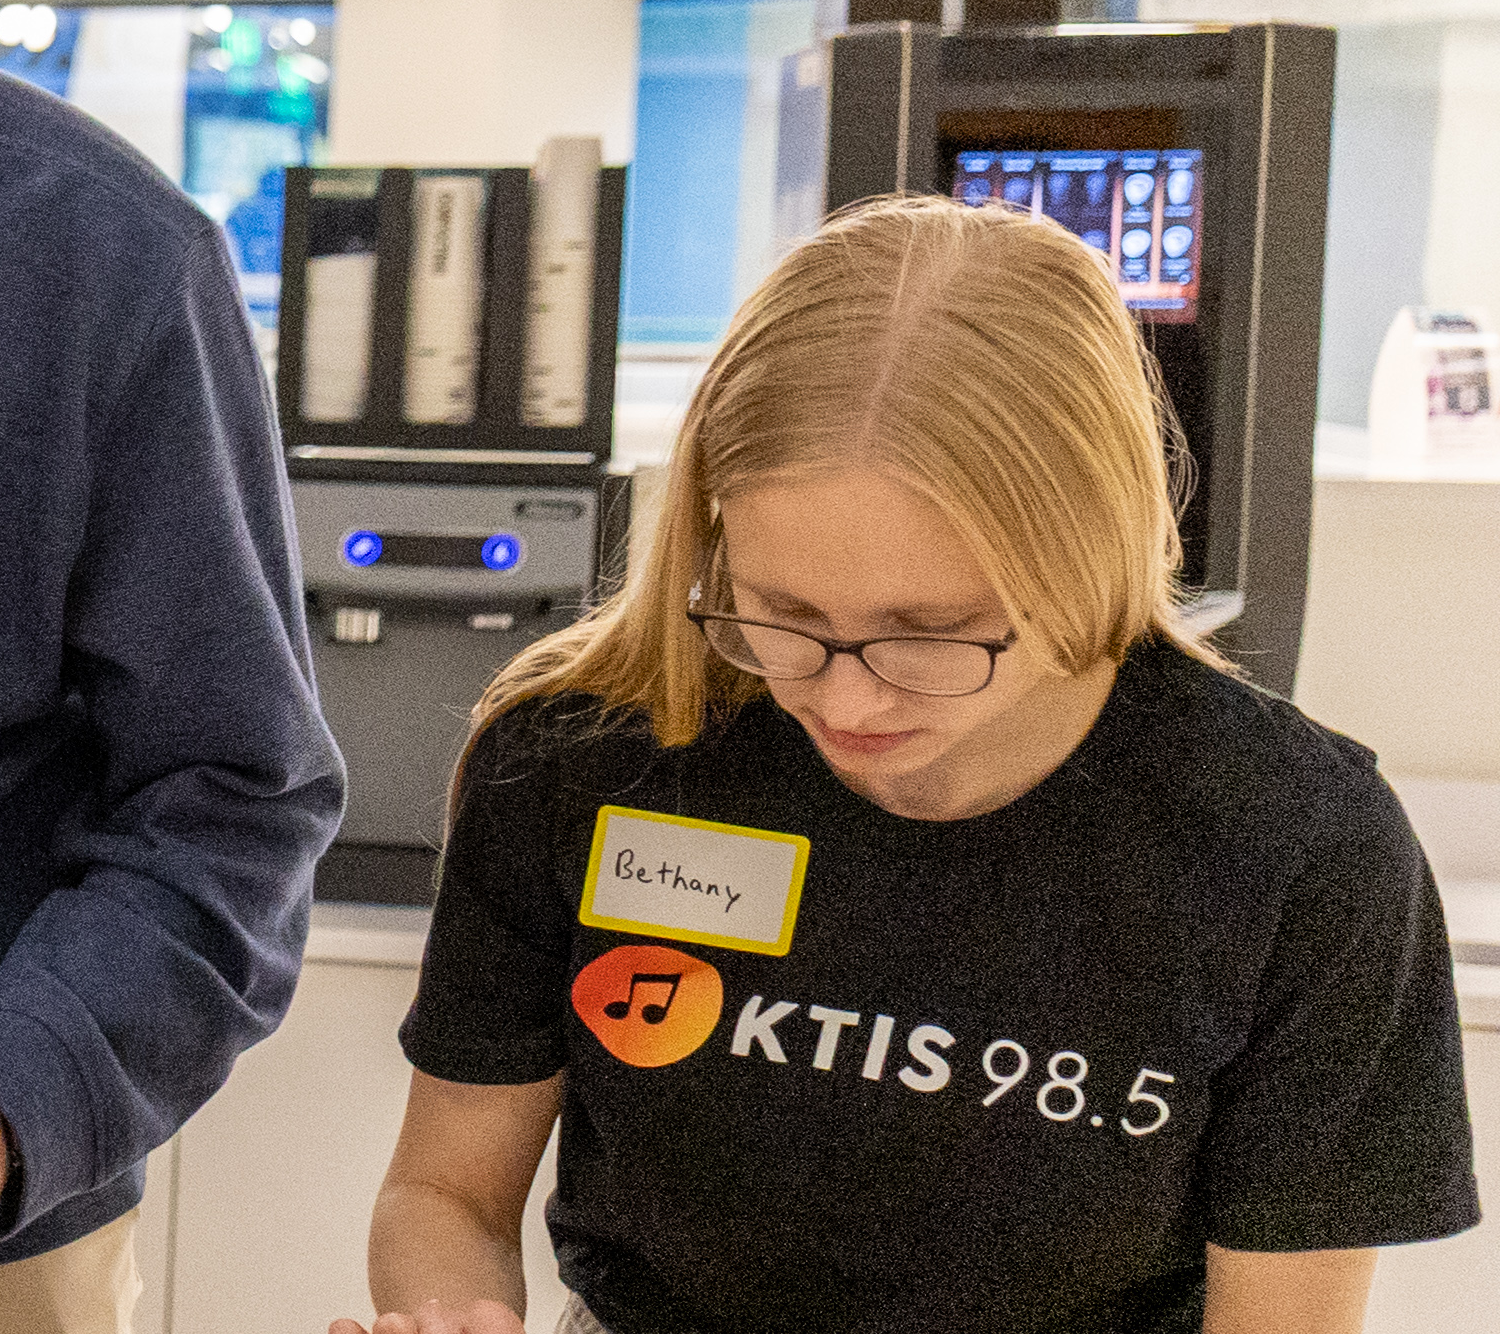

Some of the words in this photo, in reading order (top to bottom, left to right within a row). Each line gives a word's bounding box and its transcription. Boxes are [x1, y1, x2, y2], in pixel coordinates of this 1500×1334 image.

[615, 849, 741, 913] Bethany
[730, 995, 956, 1092] KTIS
[982, 1039, 1175, 1136] 98.5
